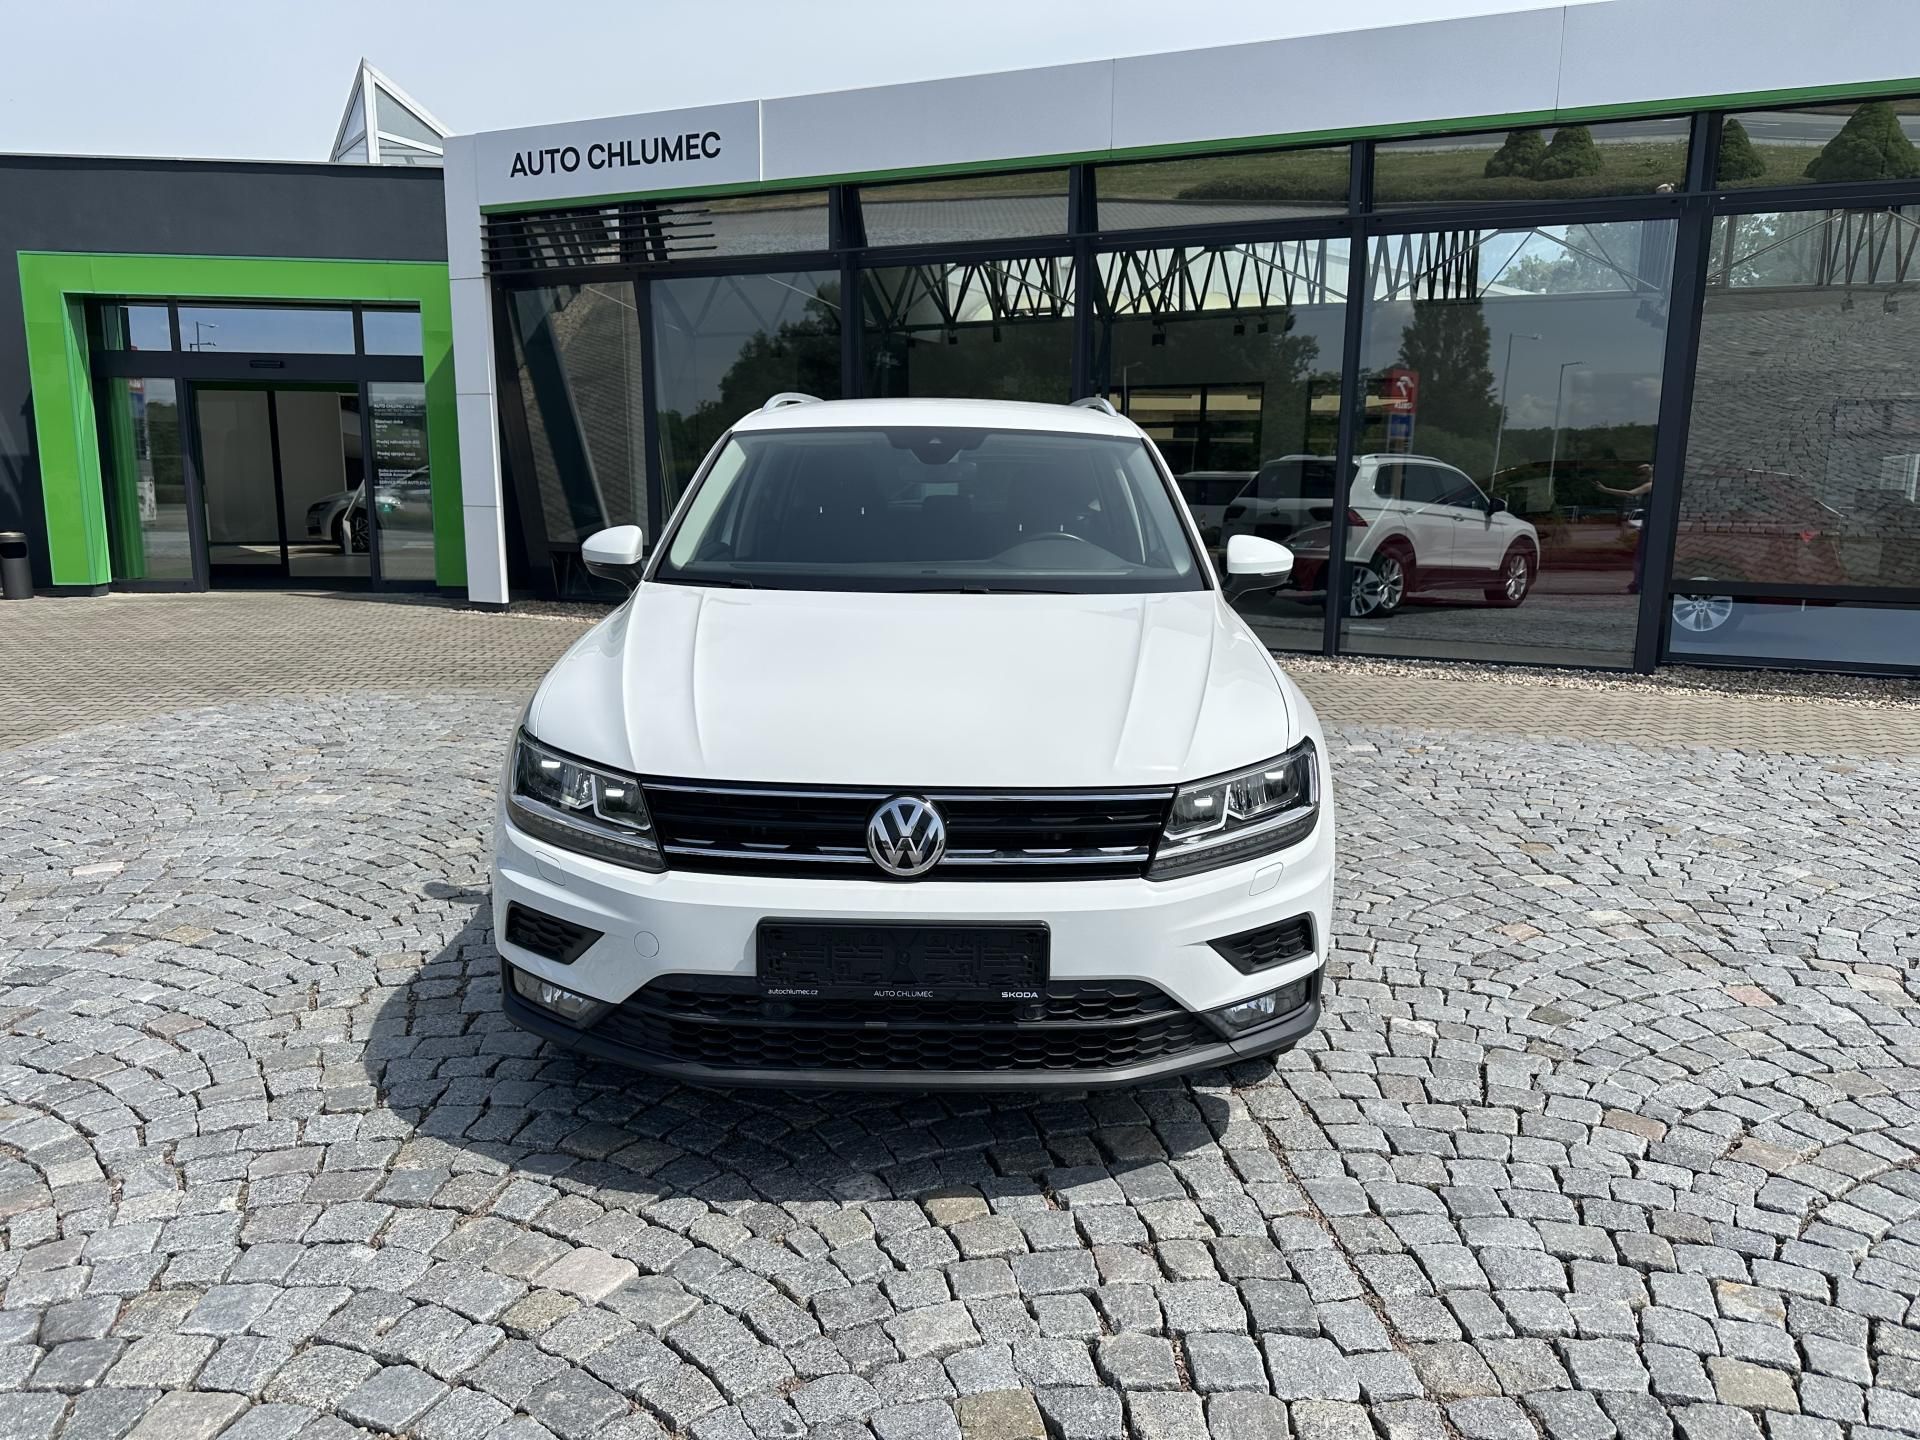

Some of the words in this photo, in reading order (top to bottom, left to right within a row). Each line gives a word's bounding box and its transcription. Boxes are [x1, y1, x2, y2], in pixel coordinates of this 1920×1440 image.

[510, 146, 580, 178] AUTO
[587, 131, 721, 169] CHLUMEC
[868, 797, 945, 876] VW
[873, 989, 896, 997] AUTO
[896, 990, 934, 998] CHLUMEC
